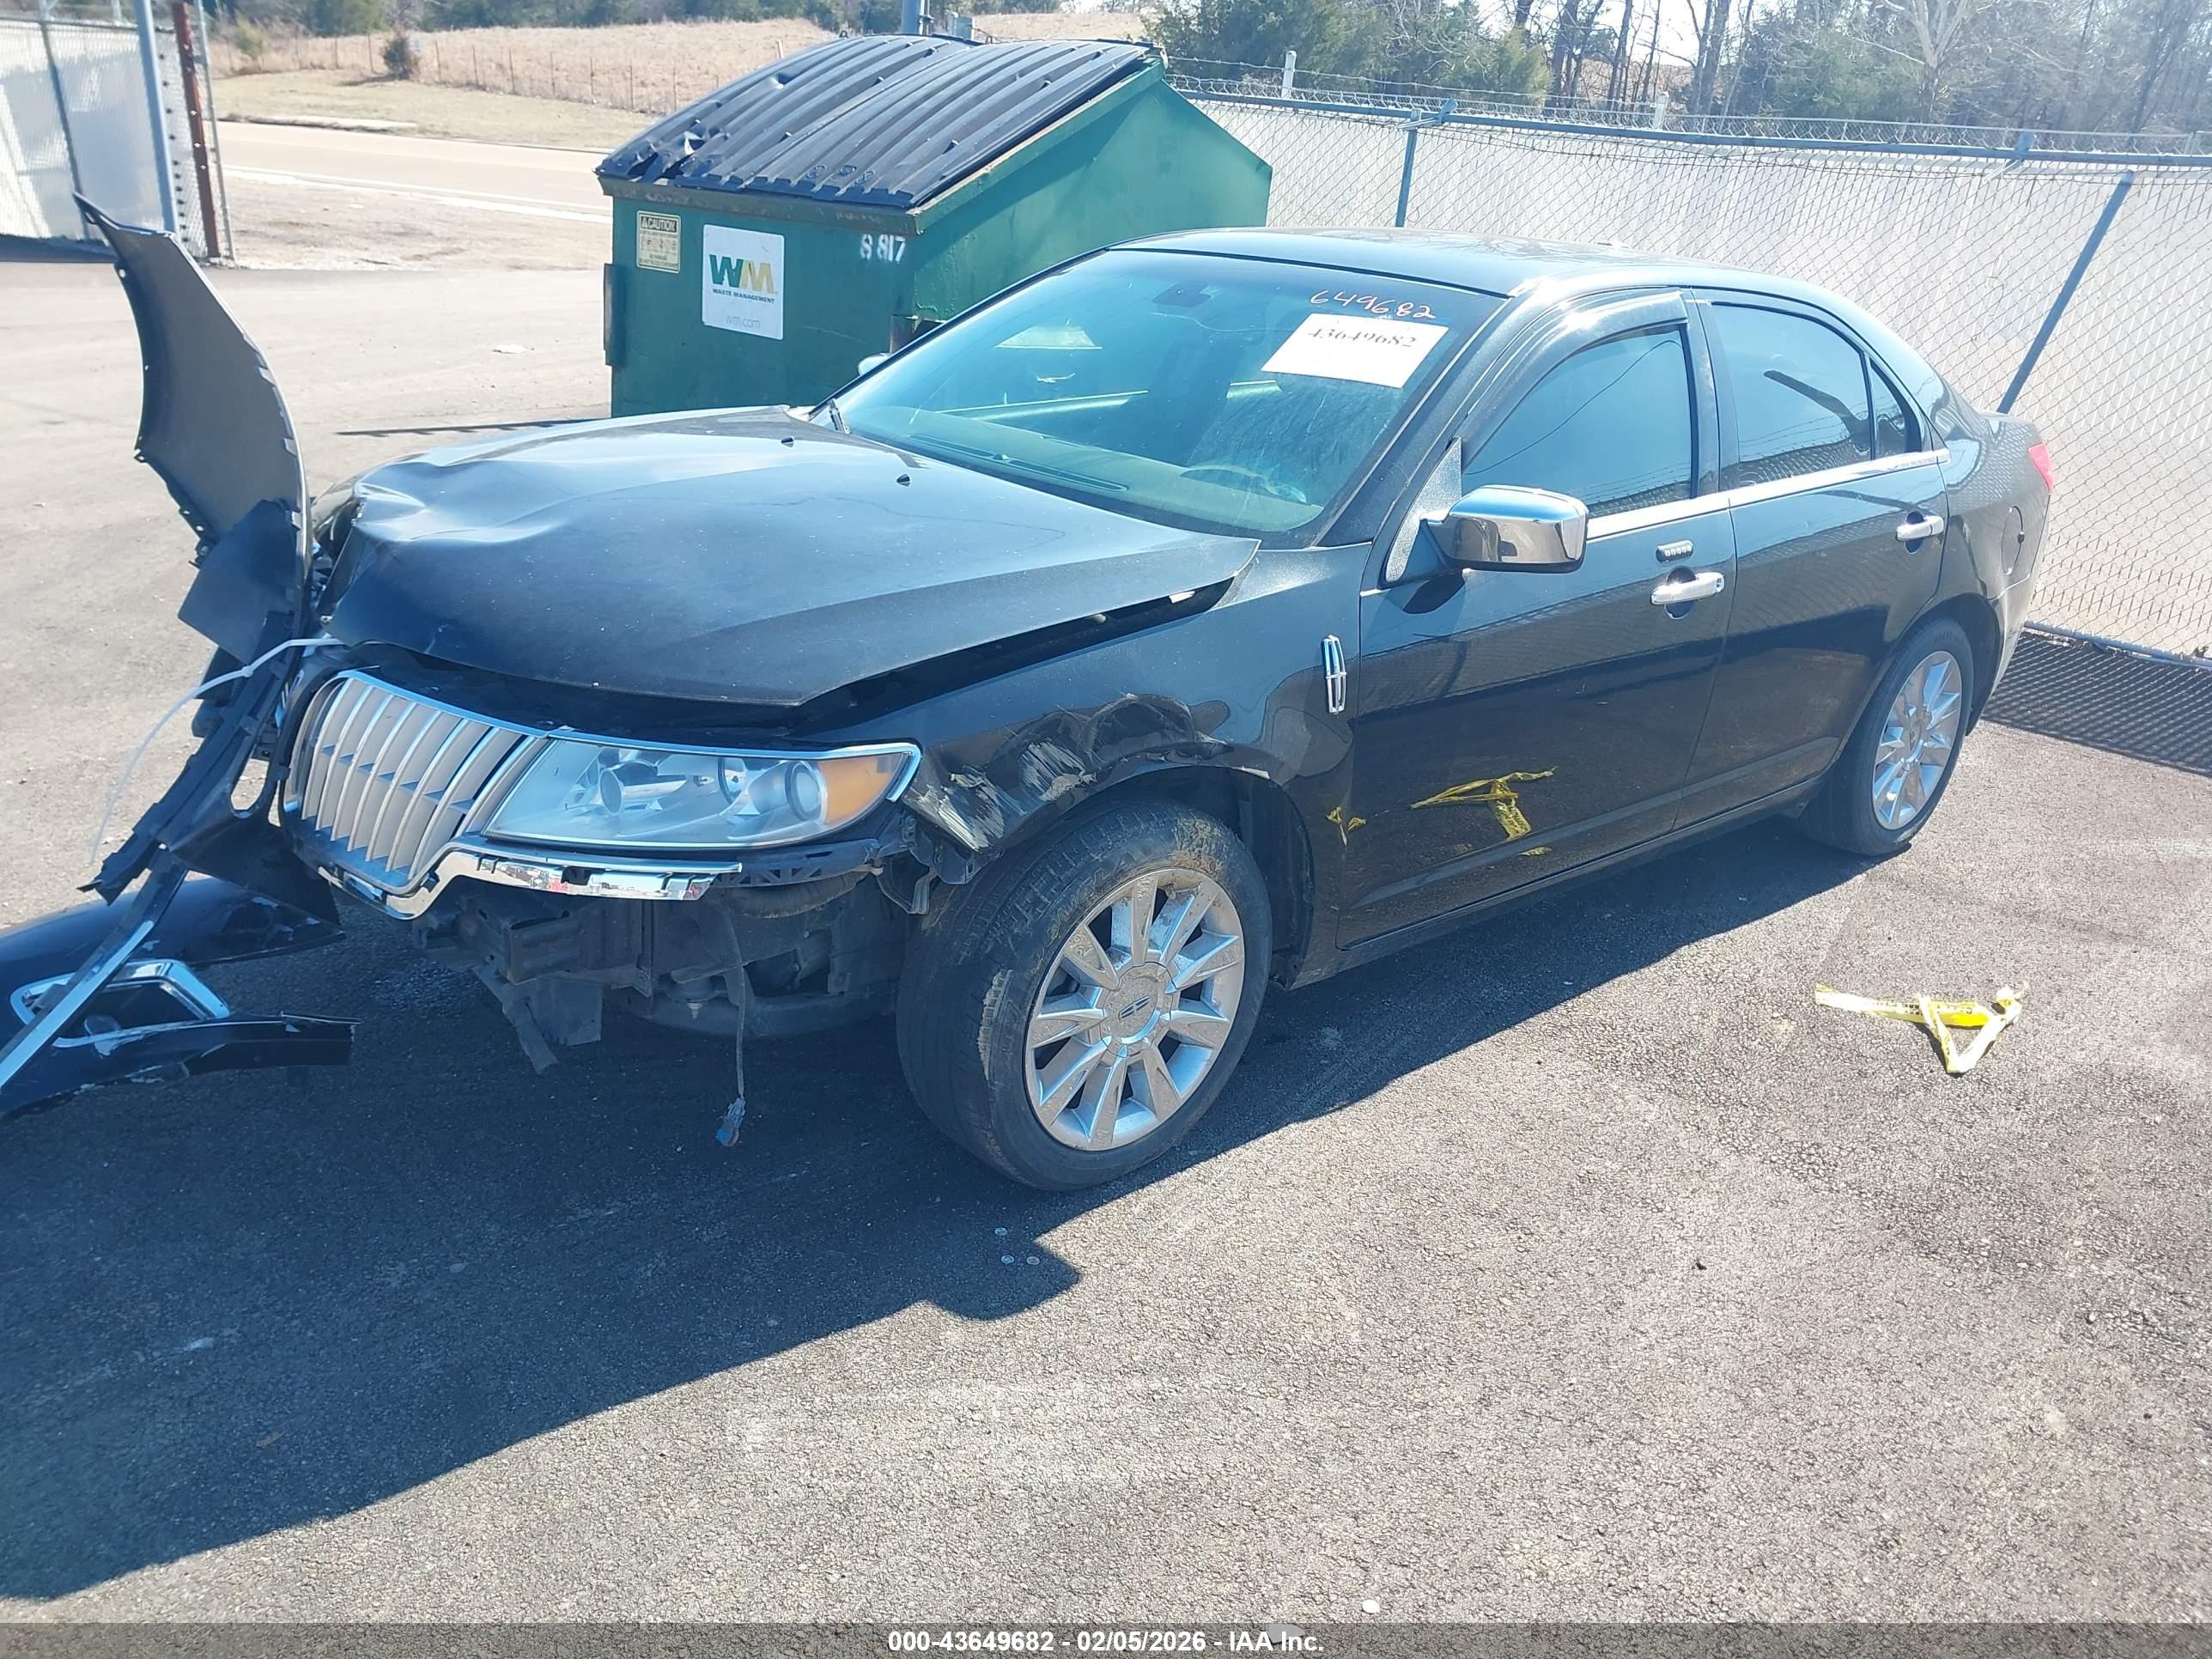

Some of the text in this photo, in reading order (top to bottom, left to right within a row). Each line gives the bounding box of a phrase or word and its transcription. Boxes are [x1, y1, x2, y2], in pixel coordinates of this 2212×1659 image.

[709, 254, 775, 294] WM
[712, 288, 775, 304] WASTE MANAGEMENT
[1310, 289, 1437, 319] 649682
